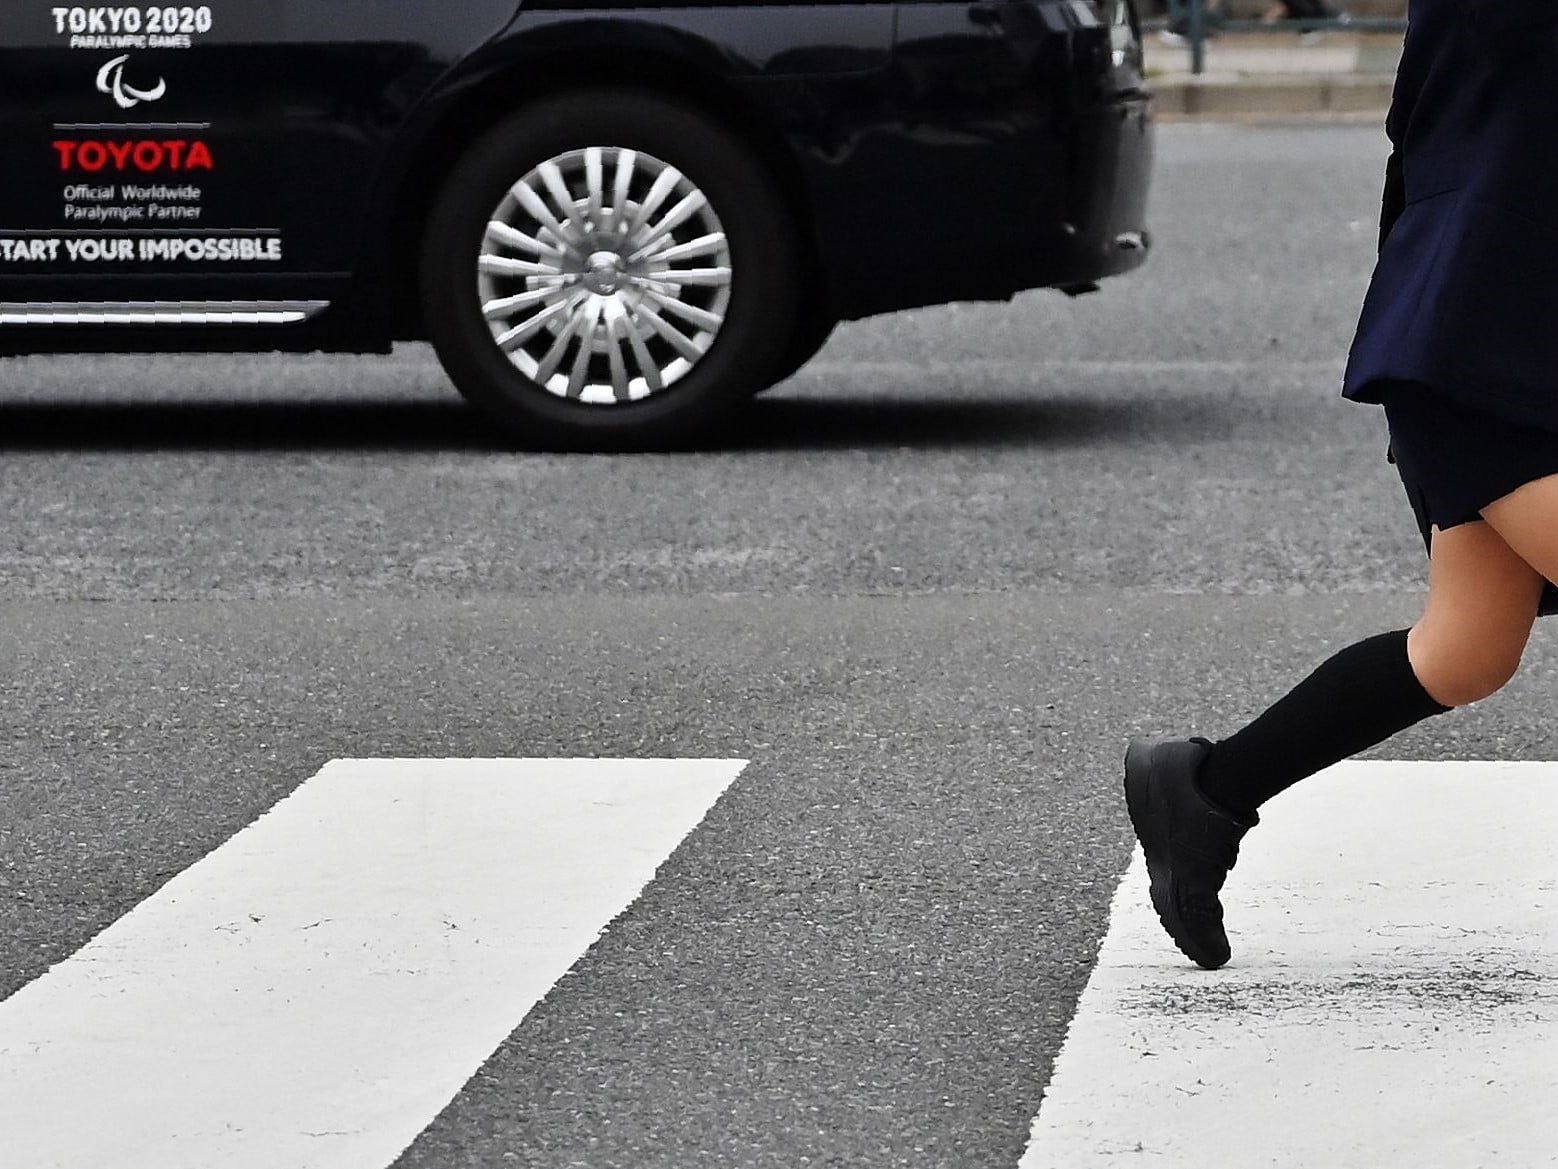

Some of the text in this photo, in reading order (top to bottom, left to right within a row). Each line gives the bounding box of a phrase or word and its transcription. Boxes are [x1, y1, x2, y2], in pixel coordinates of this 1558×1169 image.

[52, 6, 213, 34] TOKYO 2020
[70, 34, 192, 49] PARALYMPIC GAMES
[52, 140, 214, 172] TOYOTA
[63, 184, 202, 201] Official Worldwide
[64, 203, 202, 223] Paralympic Partner
[0, 237, 282, 262] TART YOUR IMPOSSIBLE
